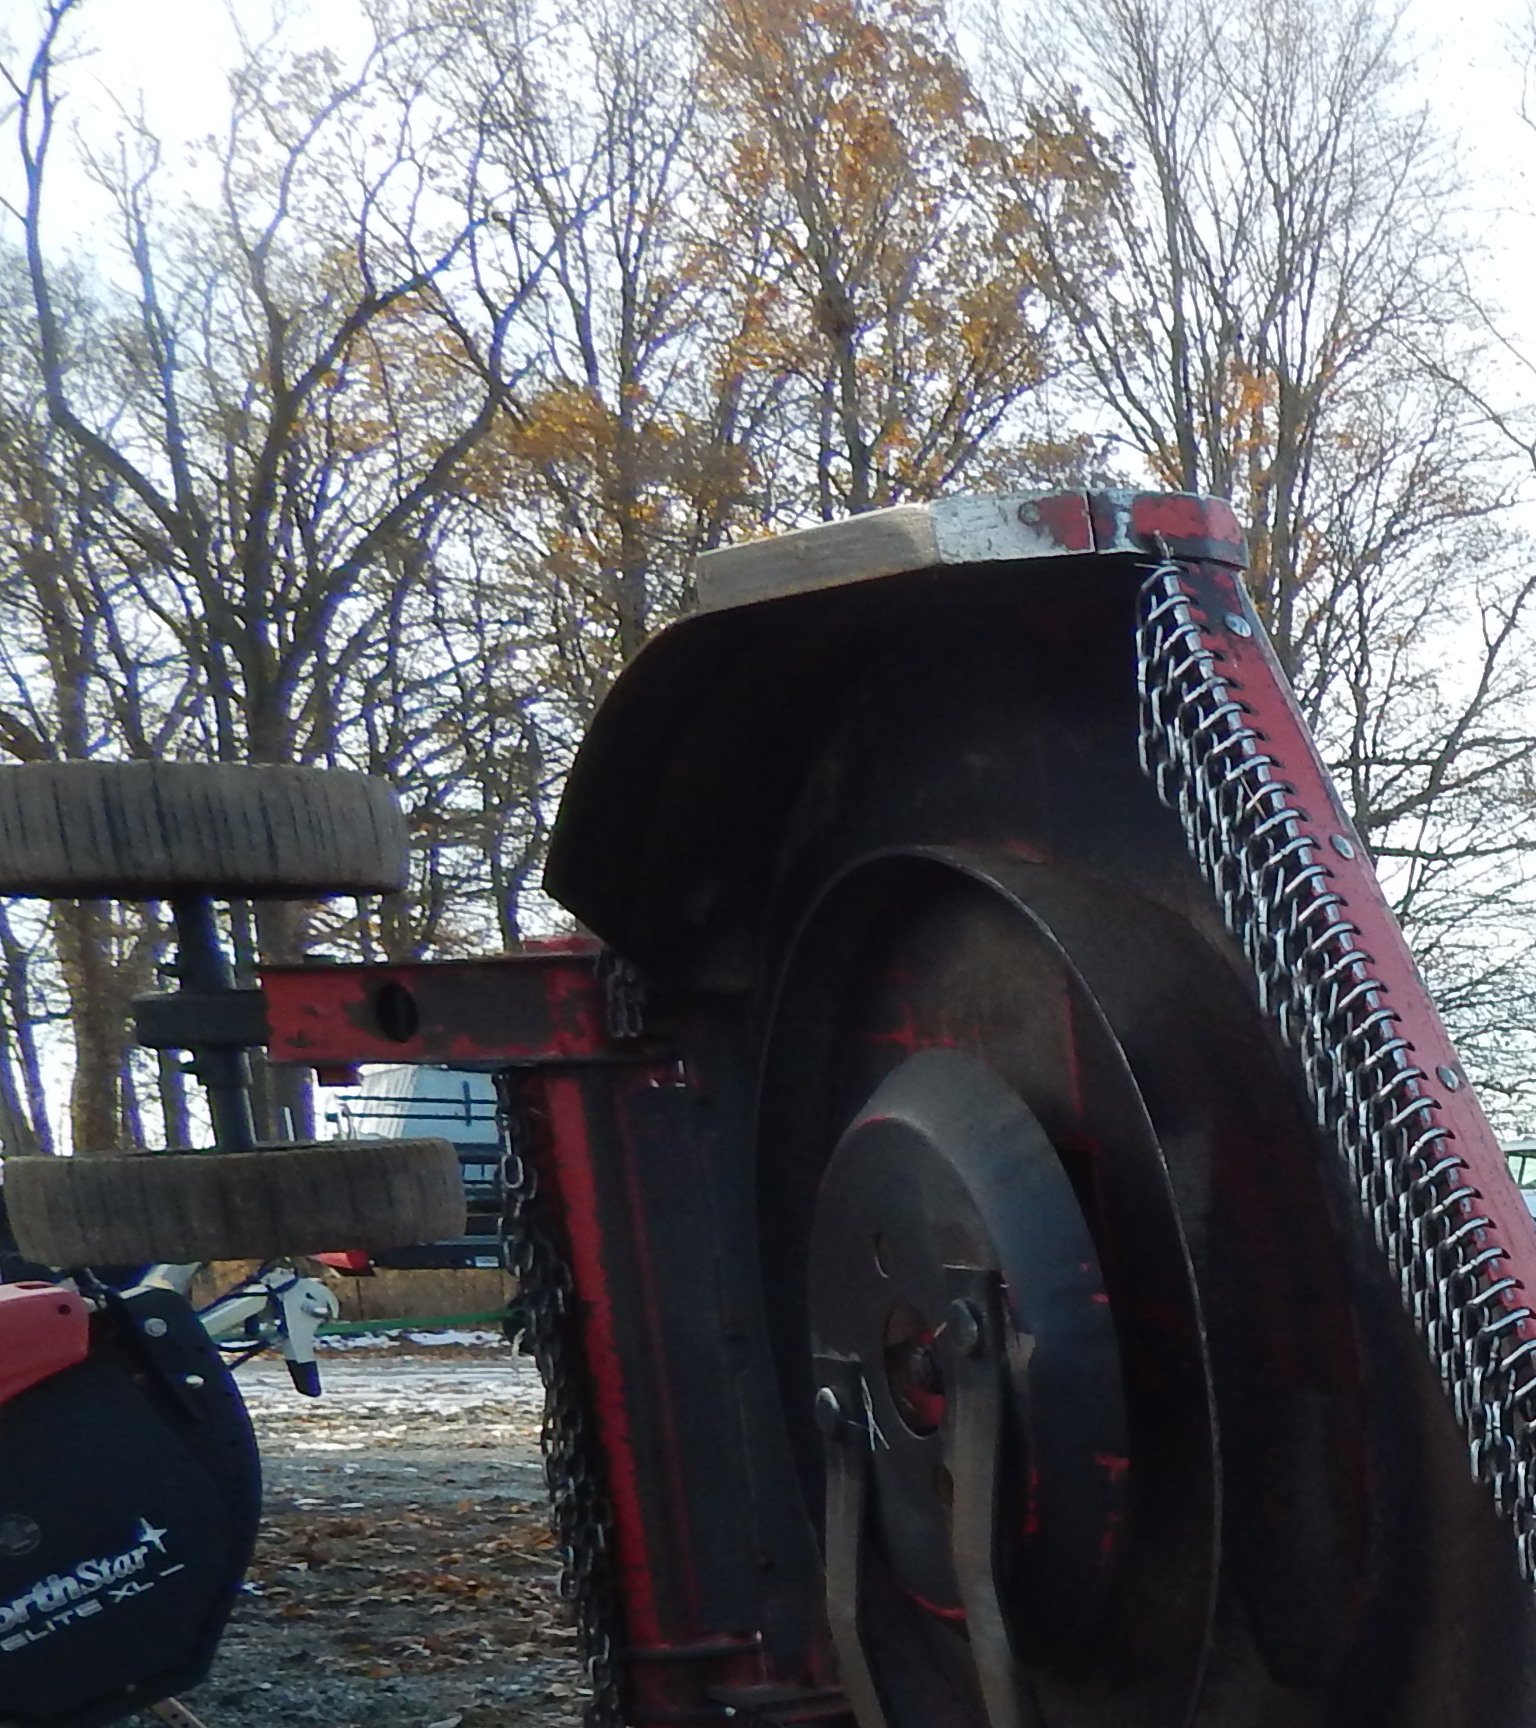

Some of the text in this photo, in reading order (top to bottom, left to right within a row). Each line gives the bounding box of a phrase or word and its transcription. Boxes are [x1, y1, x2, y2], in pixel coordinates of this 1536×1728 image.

[0, 1545, 149, 1633] orthStar
[0, 1580, 155, 1651] ELITE XL
